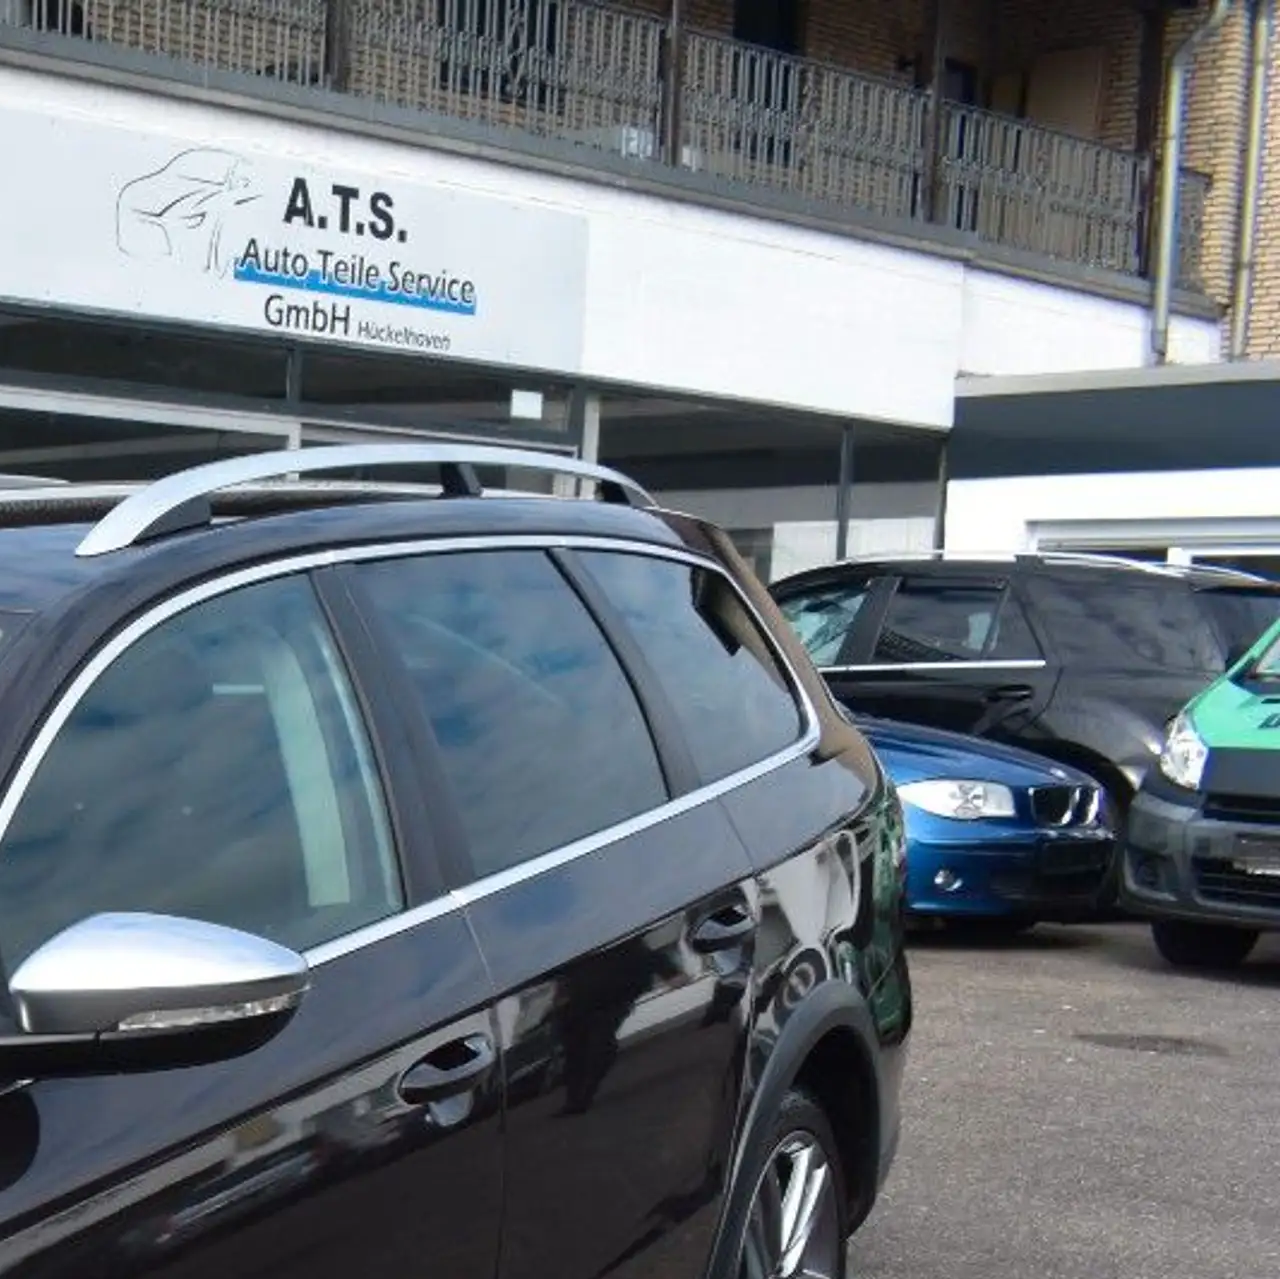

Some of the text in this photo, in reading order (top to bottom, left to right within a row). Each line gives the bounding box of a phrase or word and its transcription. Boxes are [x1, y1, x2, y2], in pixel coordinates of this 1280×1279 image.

[282, 176, 408, 244] A.T.S.
[239, 237, 476, 304] Auto Teile Service
[263, 294, 452, 351] GmbH Hückelhoven
